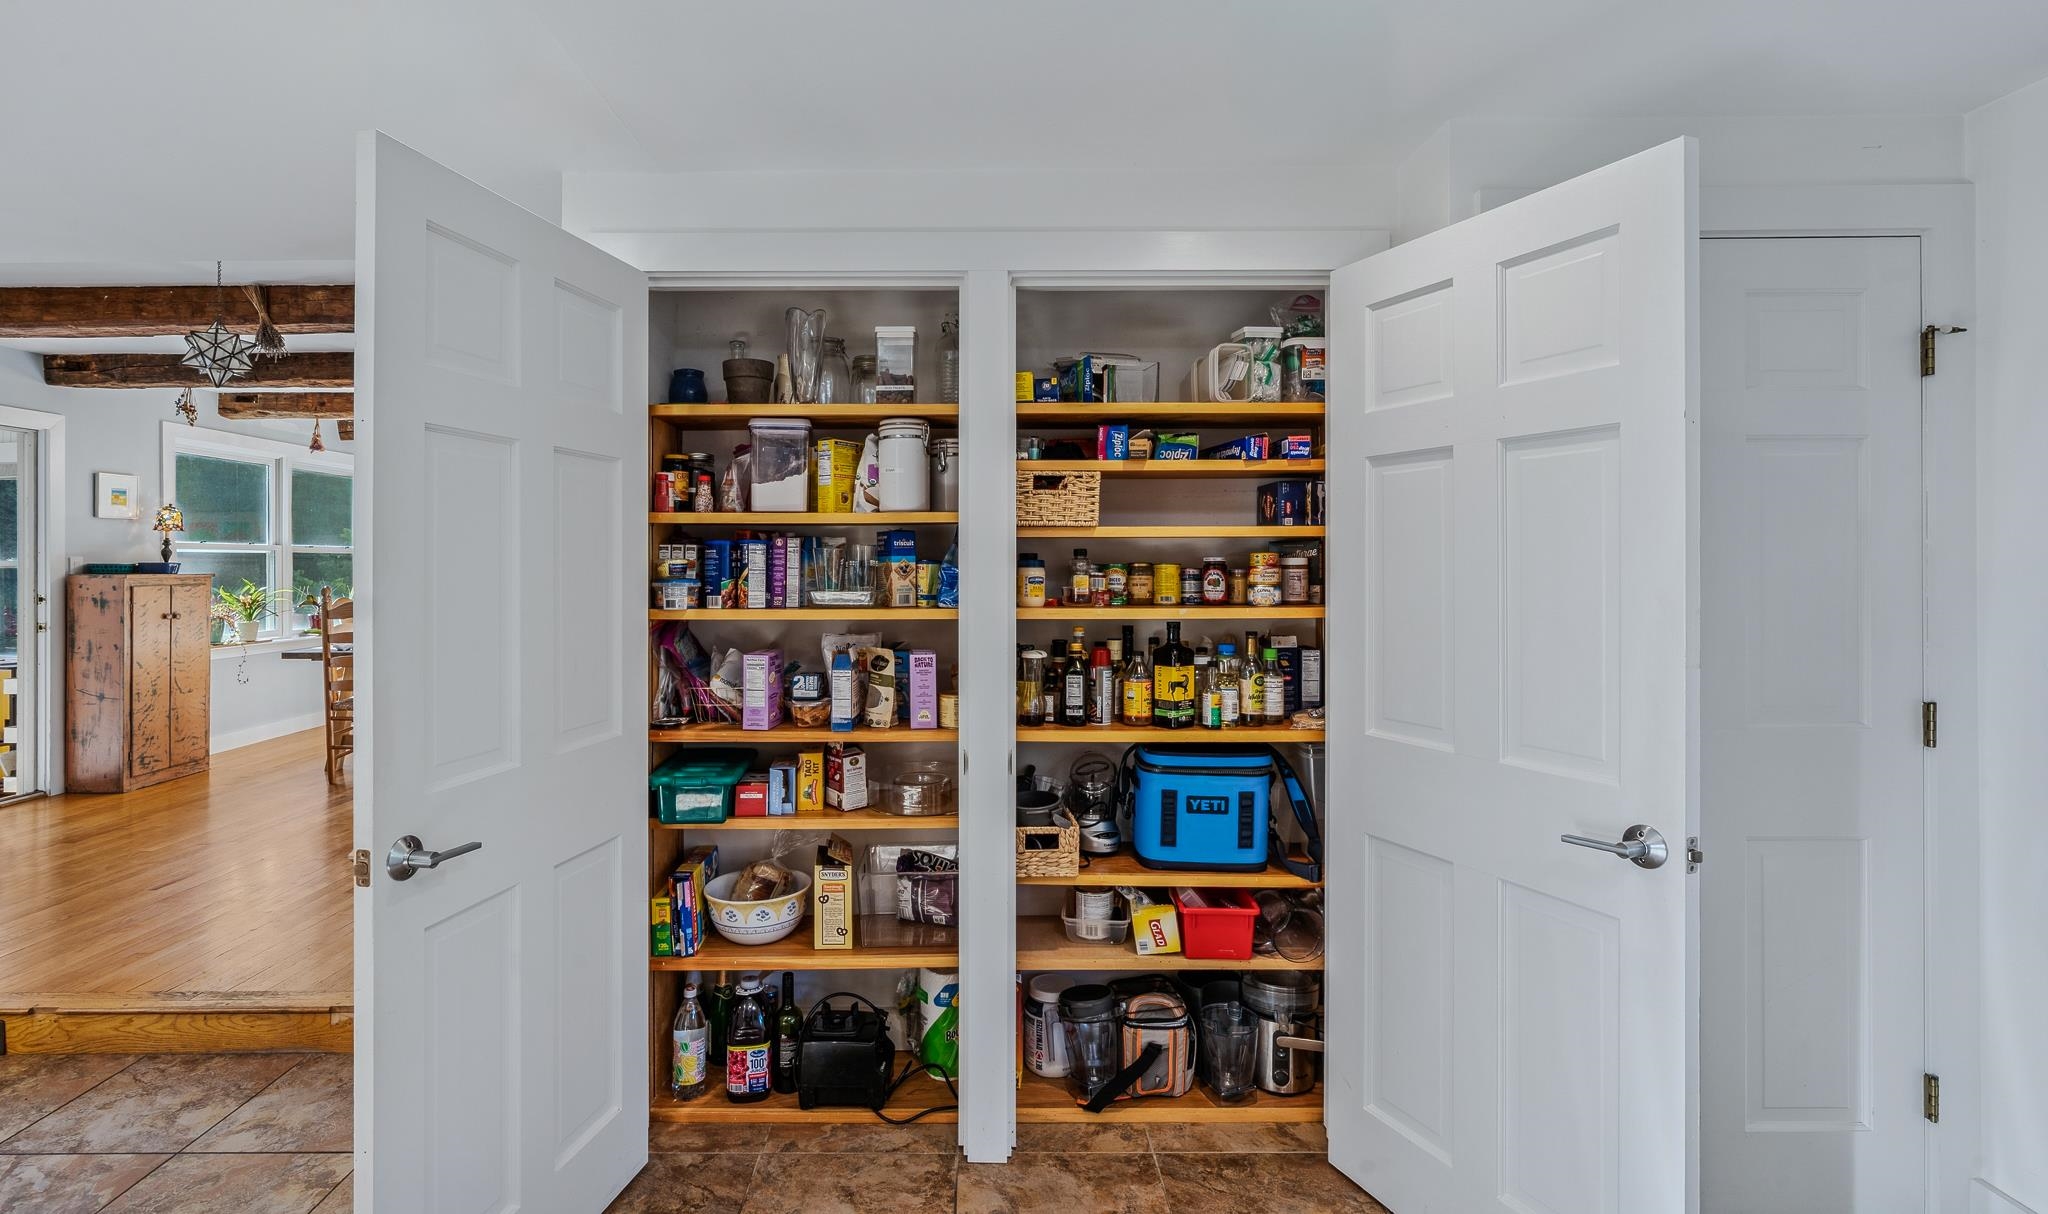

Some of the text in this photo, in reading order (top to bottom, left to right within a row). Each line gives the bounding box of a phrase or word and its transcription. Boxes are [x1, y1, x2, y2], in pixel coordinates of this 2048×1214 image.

[1112, 431, 1124, 458] Ziploc
[1160, 448, 1189, 460] Ziploc
[1221, 446, 1240, 458] Reynolds
[804, 760, 812, 777] TACO
[1190, 799, 1225, 811] YETI
[1151, 921, 1165, 946] GLAD
